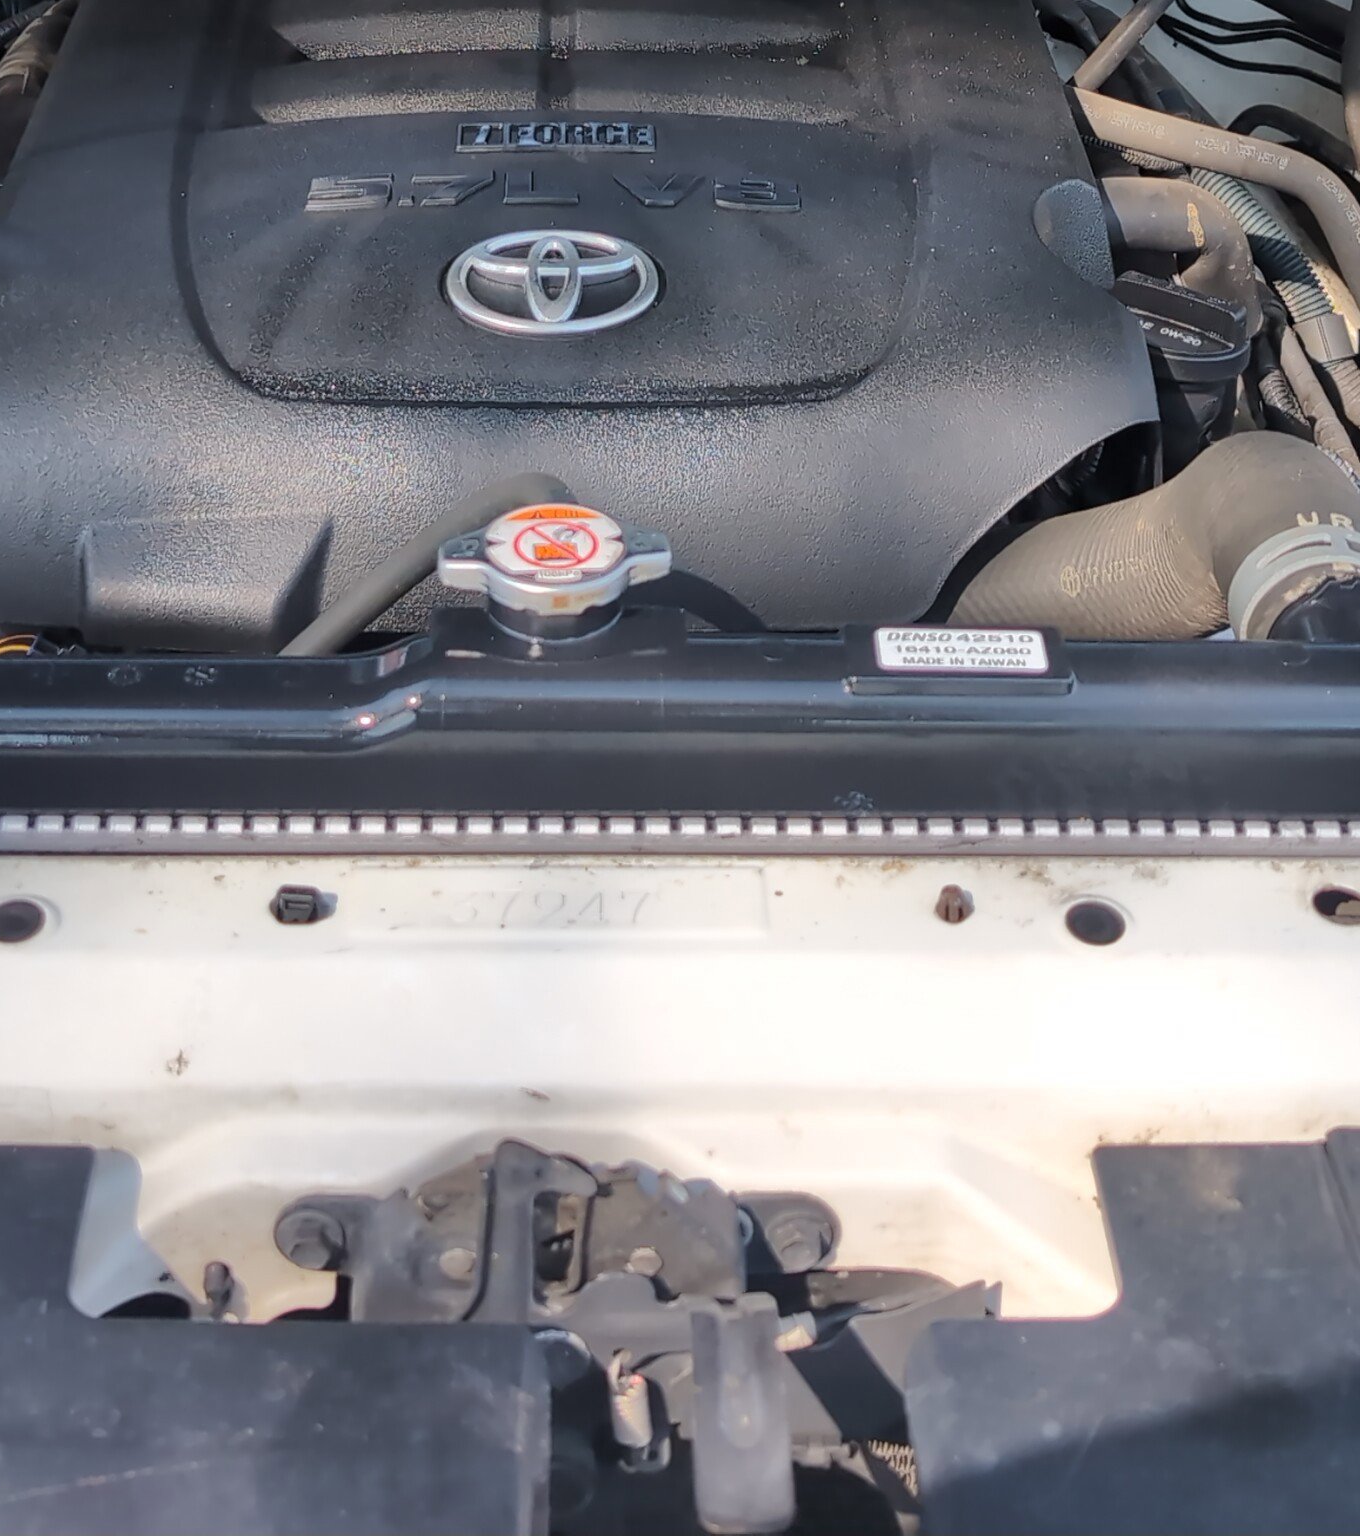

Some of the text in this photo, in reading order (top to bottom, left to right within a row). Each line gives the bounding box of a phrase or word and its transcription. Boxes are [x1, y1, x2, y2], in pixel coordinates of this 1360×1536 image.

[303, 169, 802, 212] 5.7L V8
[887, 632, 1034, 643] DENSO 42510
[903, 657, 1026, 666] MADE IN TAIWAN
